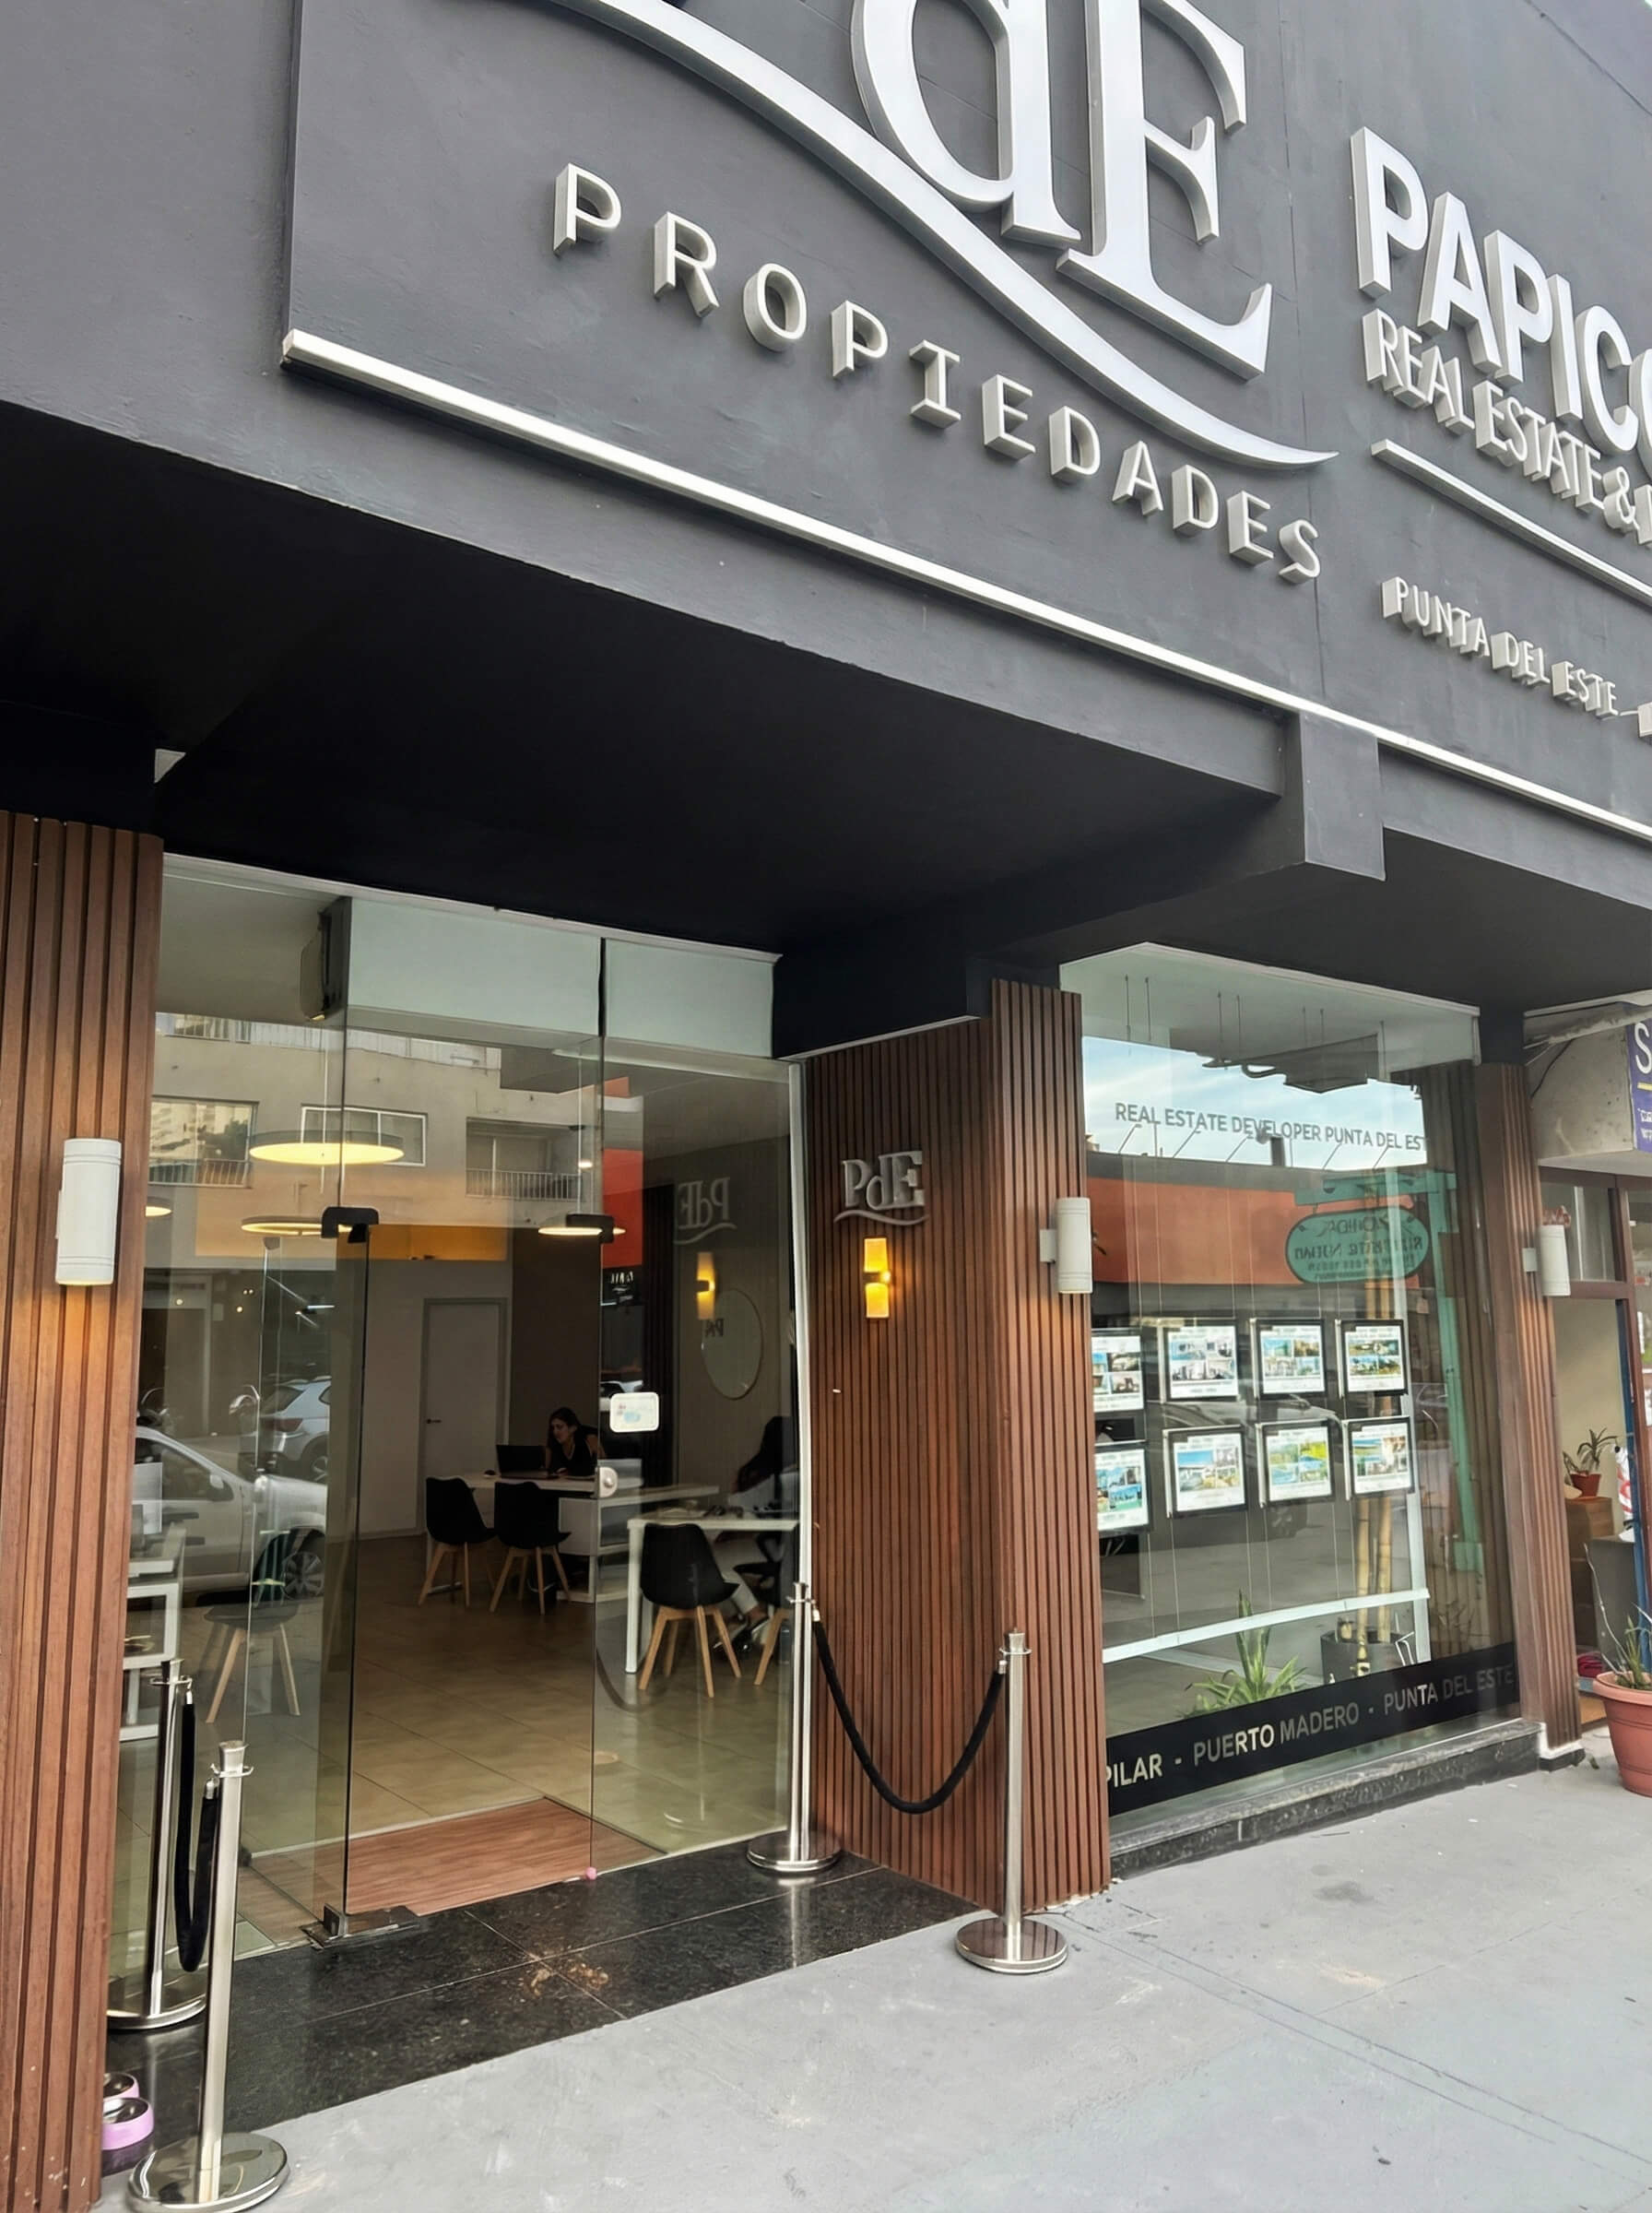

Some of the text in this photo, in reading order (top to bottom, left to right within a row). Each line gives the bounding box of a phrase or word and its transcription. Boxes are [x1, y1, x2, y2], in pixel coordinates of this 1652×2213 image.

[552, 163, 1320, 585] PROPIEDADES
[1363, 308, 1475, 435] REAL
[1473, 379, 1605, 513] ESTATE
[1602, 466, 1639, 531] &
[1382, 576, 1490, 657] PUNTA
[1491, 632, 1551, 686] DEL
[1552, 661, 1619, 718] ESTE
[1115, 1103, 1162, 1124] REAL
[1164, 1108, 1228, 1131] ESTATE
[1232, 1116, 1321, 1142] DEVELOPER
[1326, 1126, 1374, 1147] PUNTA
[1376, 1132, 1402, 1150] DEL
[1194, 1723, 1276, 1767] PUERTO
[1280, 1701, 1360, 1745] MADERO
[1384, 1684, 1439, 1716] PUNTA
[1443, 1675, 1473, 1698] DEL
[1477, 1664, 1515, 1691] ESTE
